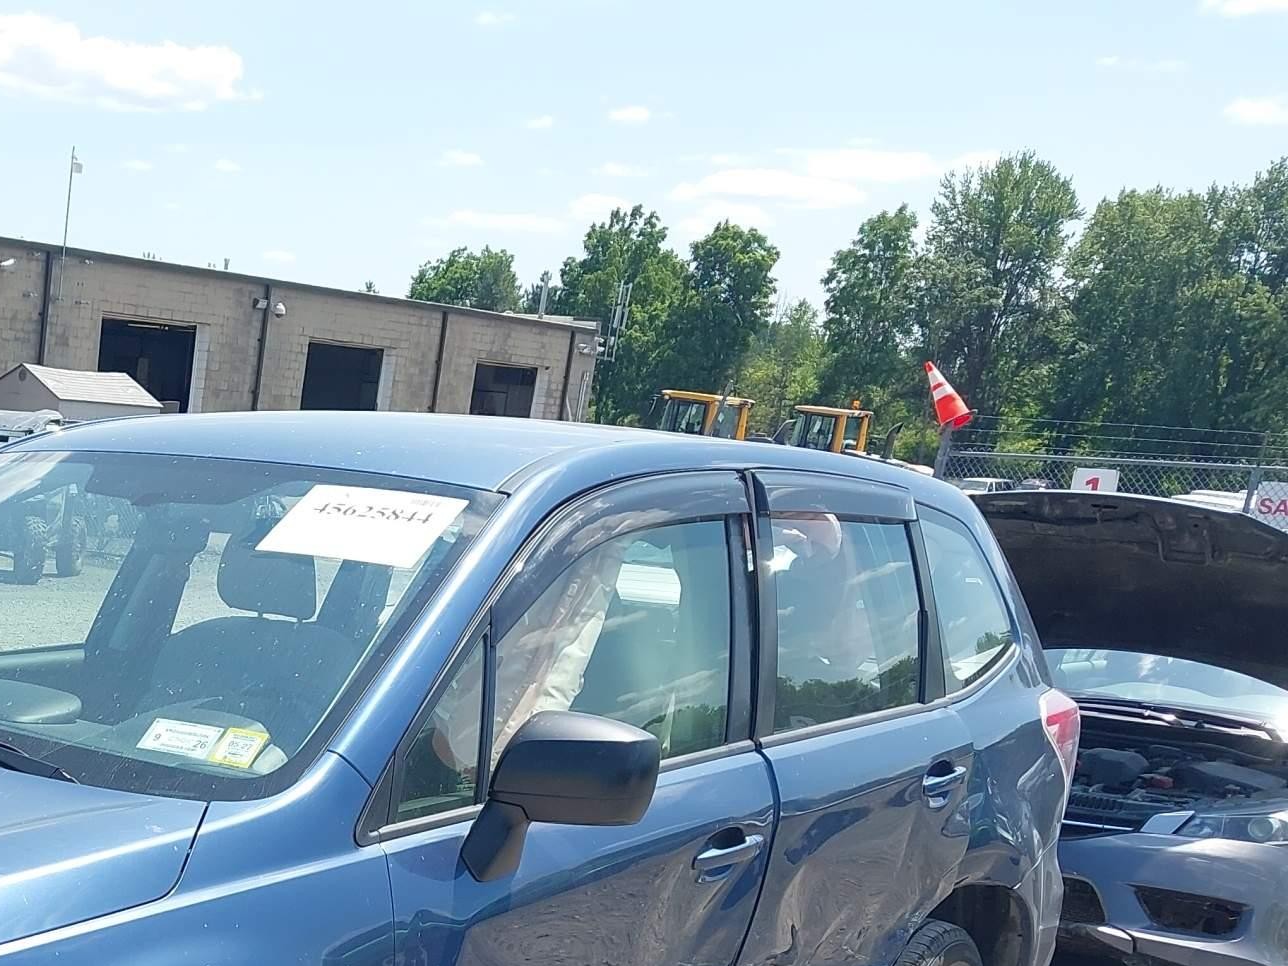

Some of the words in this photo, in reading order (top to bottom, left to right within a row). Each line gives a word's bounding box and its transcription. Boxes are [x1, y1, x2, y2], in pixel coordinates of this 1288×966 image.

[1085, 477, 1100, 491] 1
[312, 502, 434, 525] 45625844
[192, 740, 208, 750] 26
